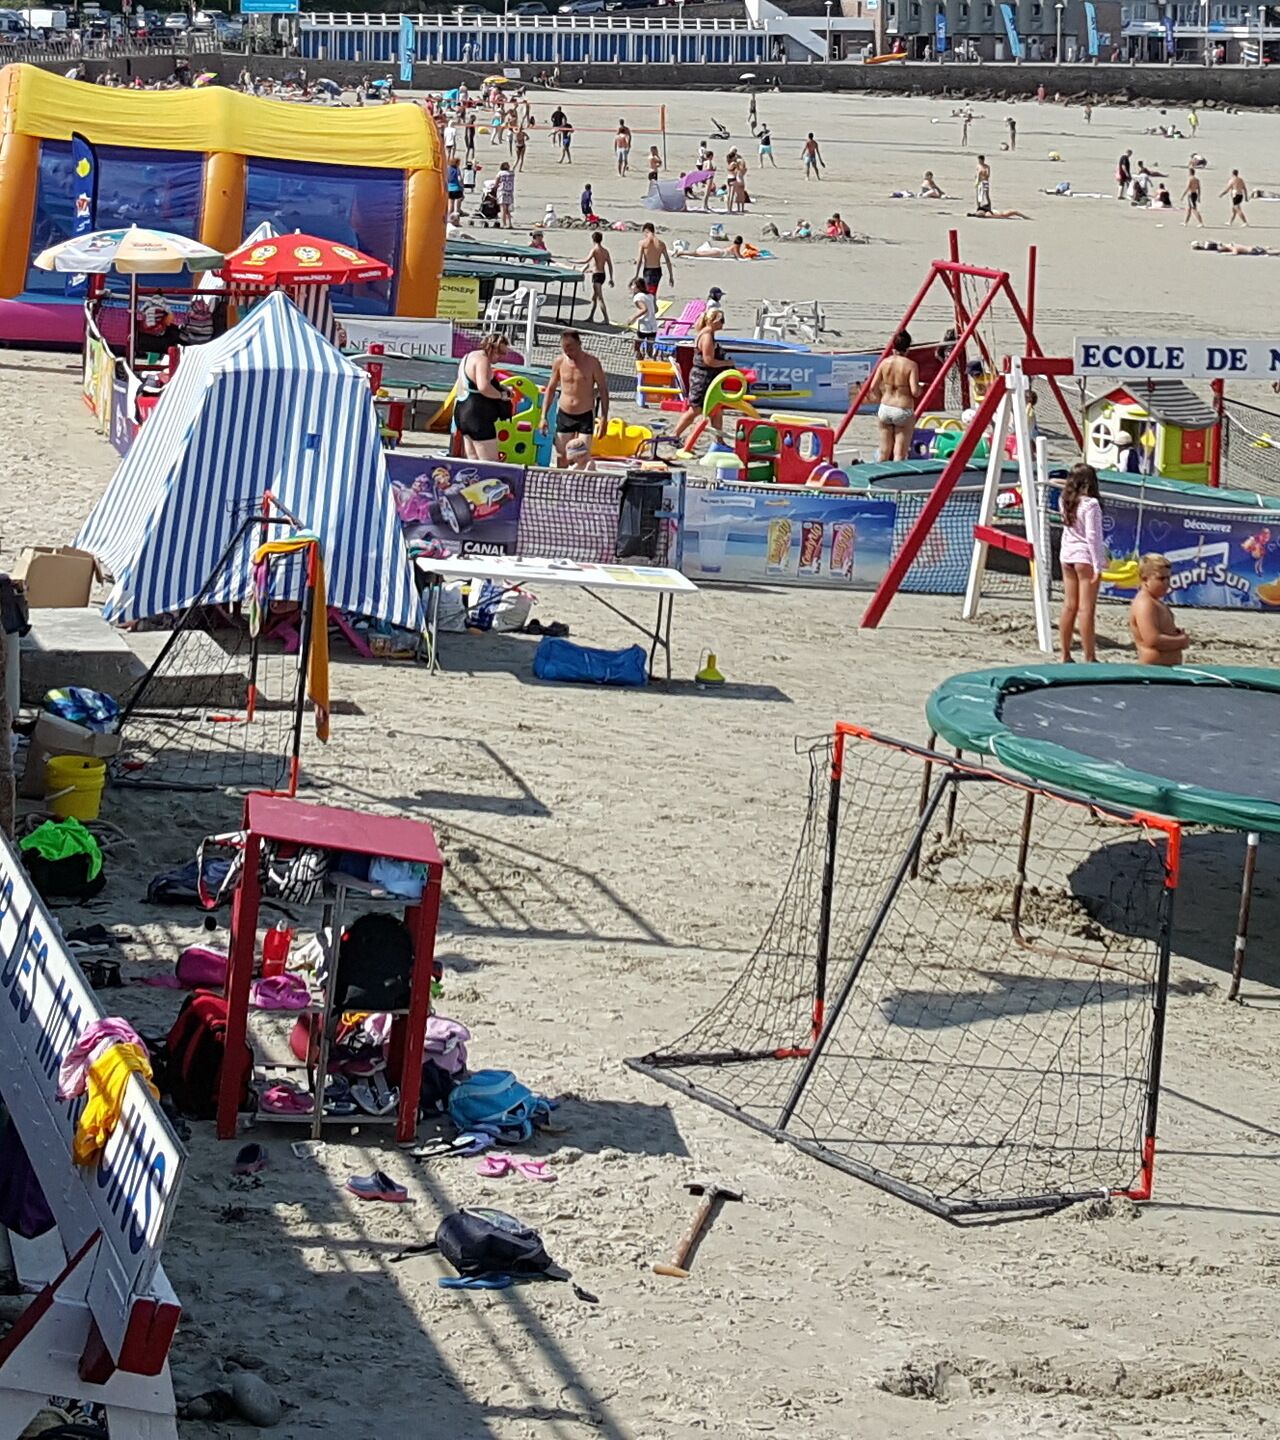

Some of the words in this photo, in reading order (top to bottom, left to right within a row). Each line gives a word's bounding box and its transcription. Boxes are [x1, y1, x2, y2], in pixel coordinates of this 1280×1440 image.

[400, 342, 448, 357] CHINE
[1081, 344, 1185, 369] ECOLE
[1206, 347, 1248, 372] DE
[754, 362, 814, 383] fizzer
[1183, 518, 1232, 533] Découvrez
[463, 542, 506, 557] CANAL
[1167, 562, 1251, 593] apri-Sun
[0, 903, 49, 1025] DES
[34, 974, 167, 1256] MAUINS
